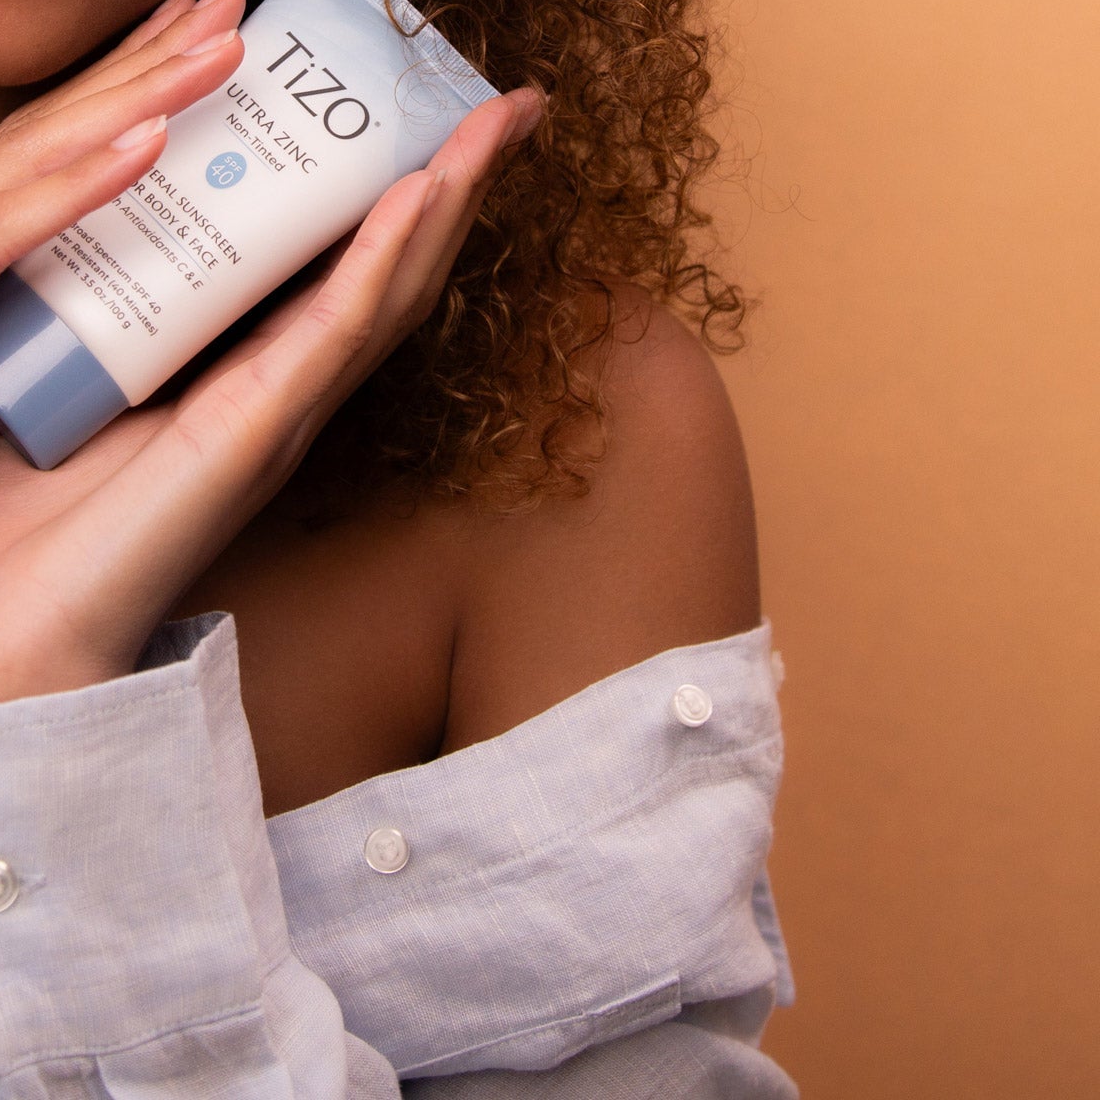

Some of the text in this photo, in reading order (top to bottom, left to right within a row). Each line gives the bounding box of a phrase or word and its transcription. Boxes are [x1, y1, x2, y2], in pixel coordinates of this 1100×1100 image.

[224, 155, 243, 172] SPF
[225, 112, 286, 172] Non-Tinted
[226, 82, 318, 174] ULTRA ZINC
[211, 165, 235, 185] 40
[118, 206, 204, 290] Antioxidants C & E
[143, 192, 180, 226] BODY
[176, 225, 190, 240] &
[188, 237, 220, 271] FACE
[175, 196, 242, 265] SUNSCREEN
[50, 245, 67, 262] Net
[66, 258, 80, 276] Wt.
[80, 272, 96, 288] 3.5
[121, 320, 132, 330] g
[56, 229, 159, 337] ter Resistant (40 Minutes)
[91, 241, 132, 283] Spectrum
[131, 281, 151, 300] SPF
[148, 301, 162, 315] 40
